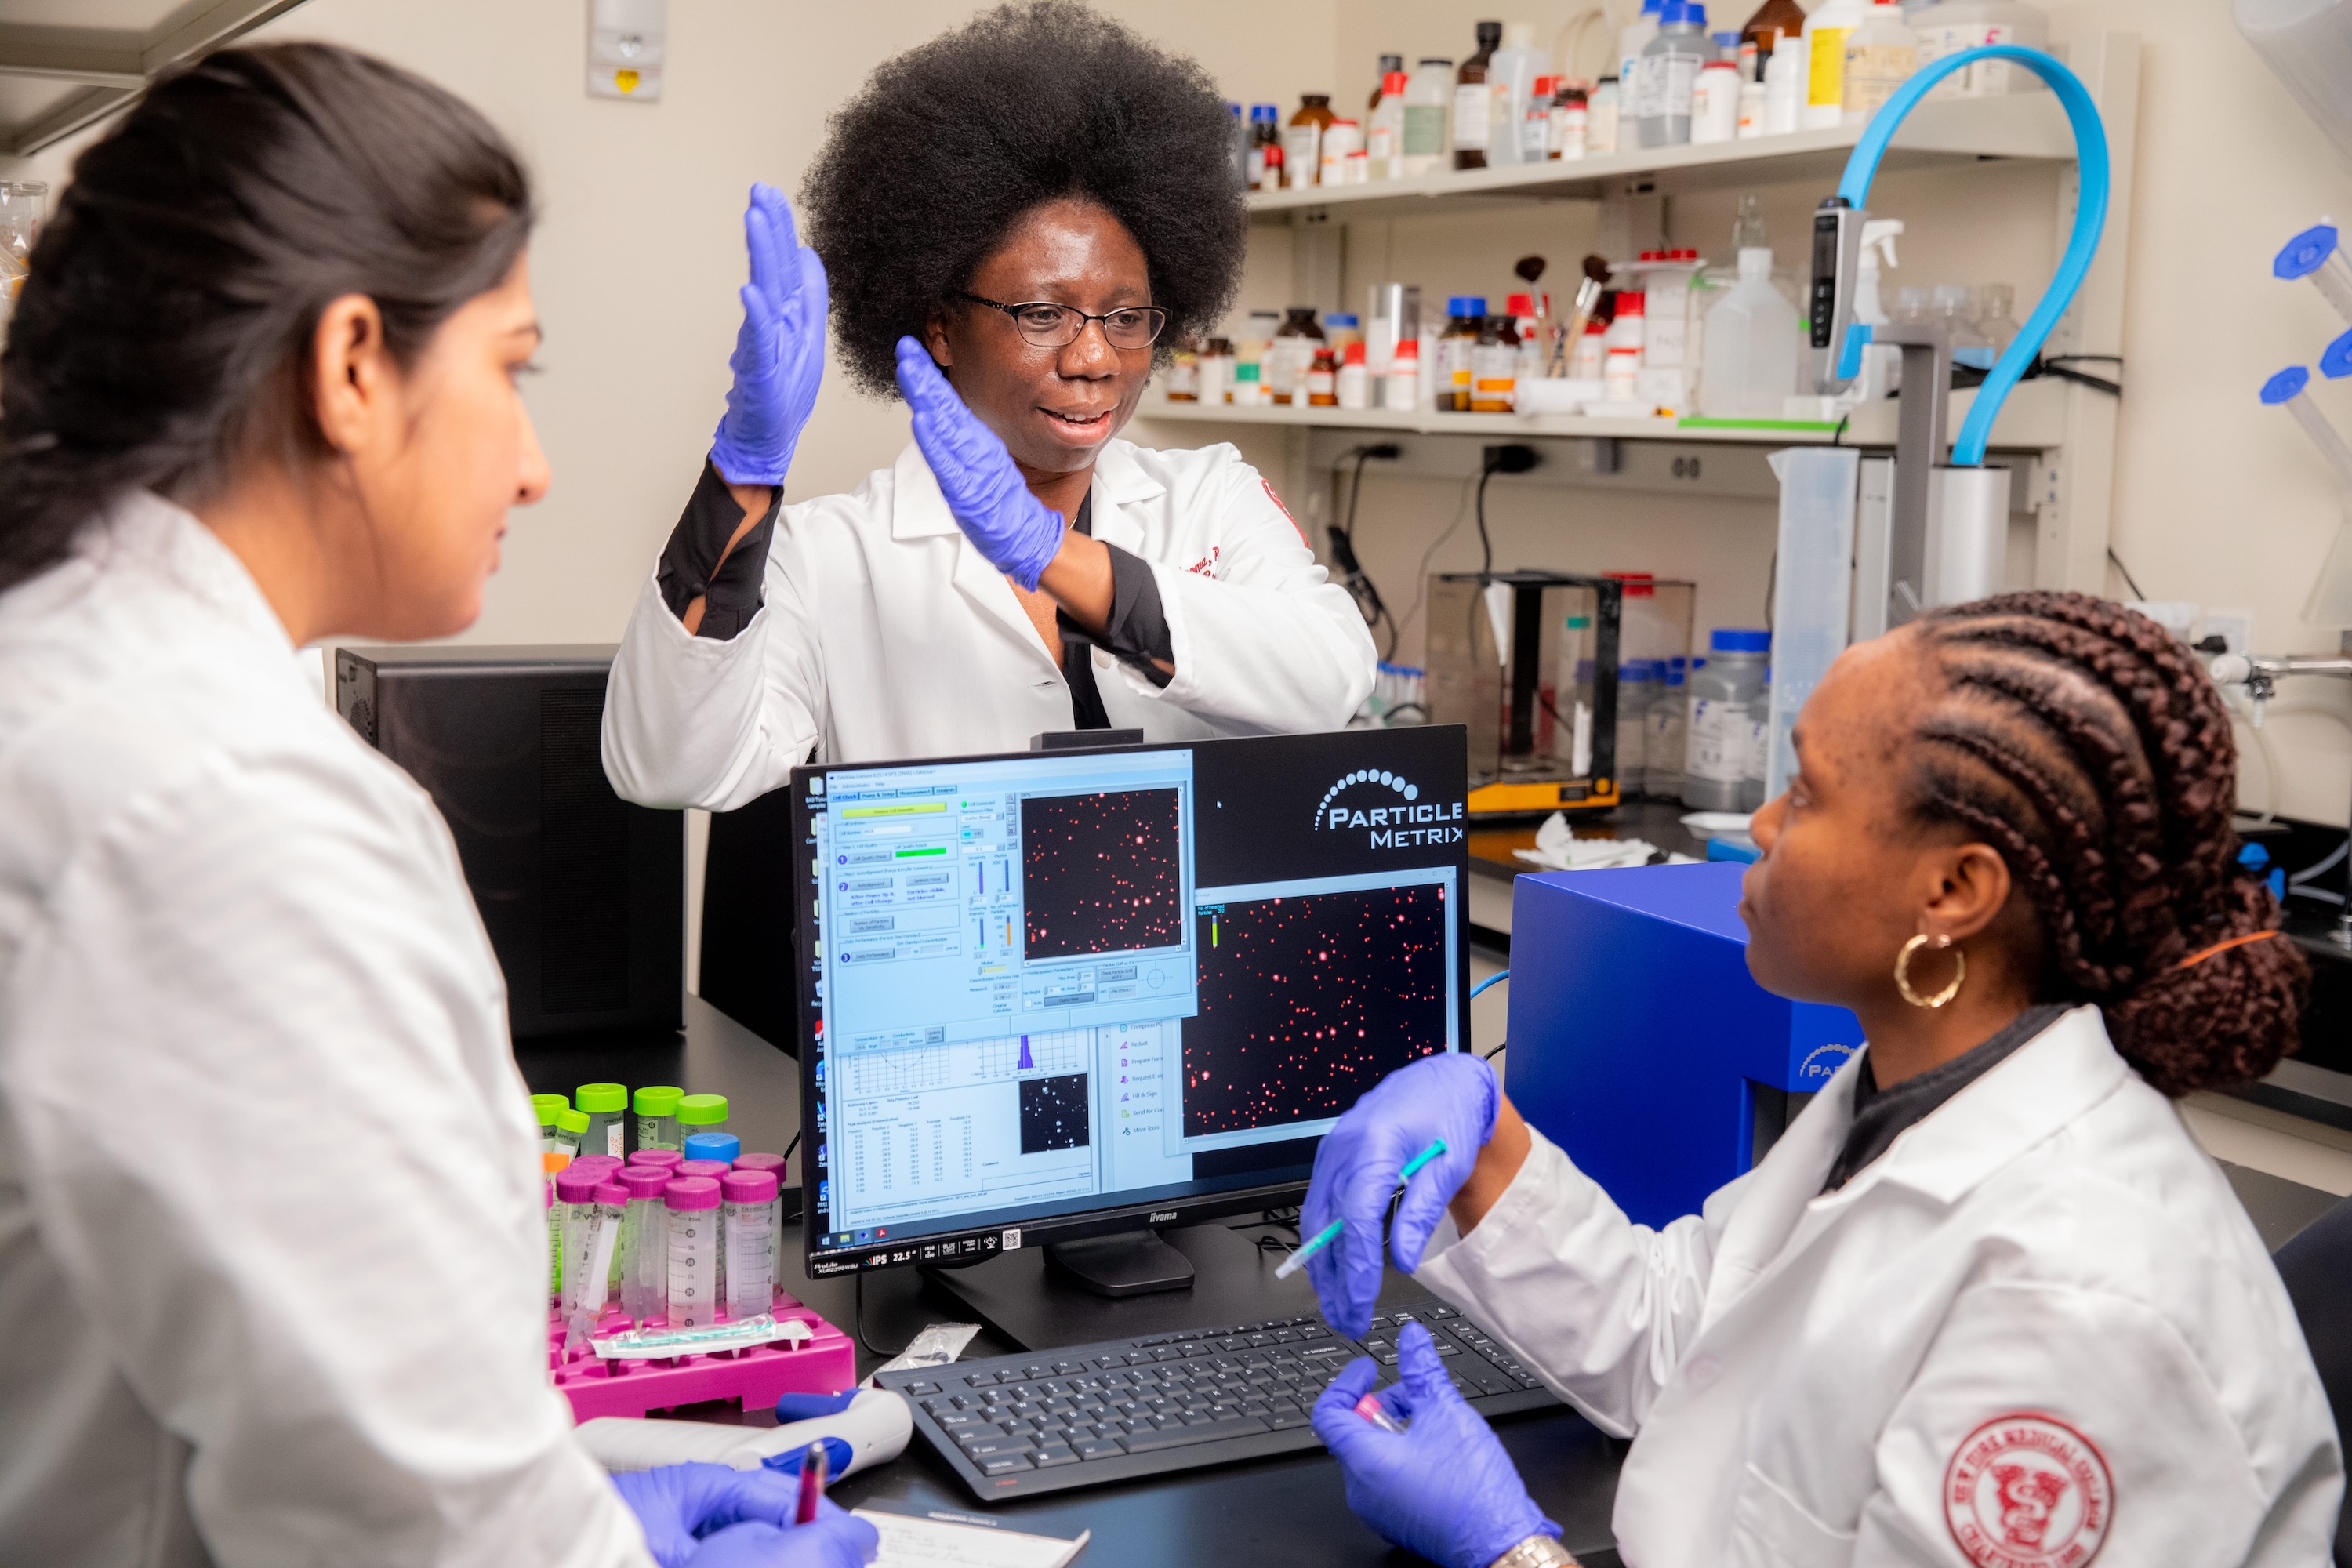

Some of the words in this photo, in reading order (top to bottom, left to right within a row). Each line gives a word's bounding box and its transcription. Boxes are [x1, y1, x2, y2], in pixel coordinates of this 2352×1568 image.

[1328, 801, 1462, 830] PARTICLE
[1370, 826, 1462, 850] METRIX
[1149, 1212, 1177, 1223] iiyama
[873, 1254, 887, 1265] IPS
